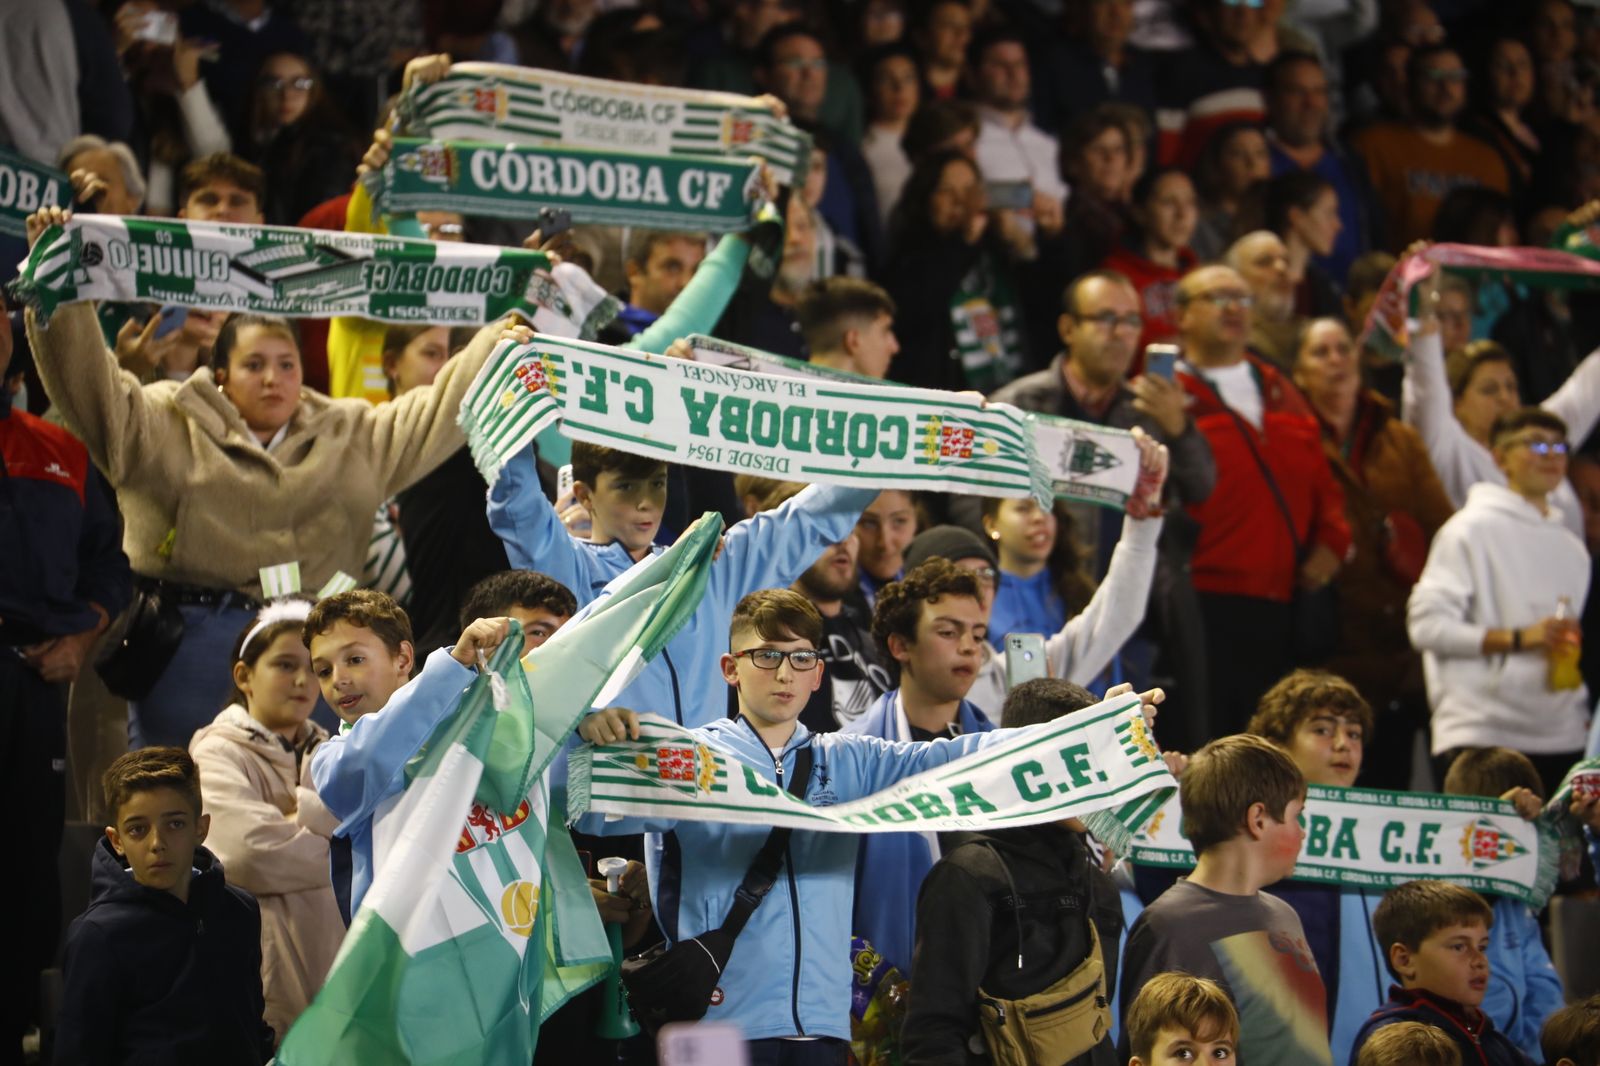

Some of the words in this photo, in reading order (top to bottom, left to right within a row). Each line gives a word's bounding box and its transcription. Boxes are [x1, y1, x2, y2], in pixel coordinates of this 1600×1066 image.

[651, 102, 677, 125] CF
[470, 141, 669, 202] CÓRDOBA
[678, 167, 732, 209] CF
[571, 361, 655, 425] C.F.
[676, 363, 779, 393] ARCÁNGEL
[783, 381, 807, 398] EL
[680, 386, 910, 469] CÓRDOBA
[687, 442, 723, 463] 1954
[727, 449, 790, 474] DESDE
[1011, 742, 1109, 803] C.F.
[1380, 820, 1442, 865] C.F.
